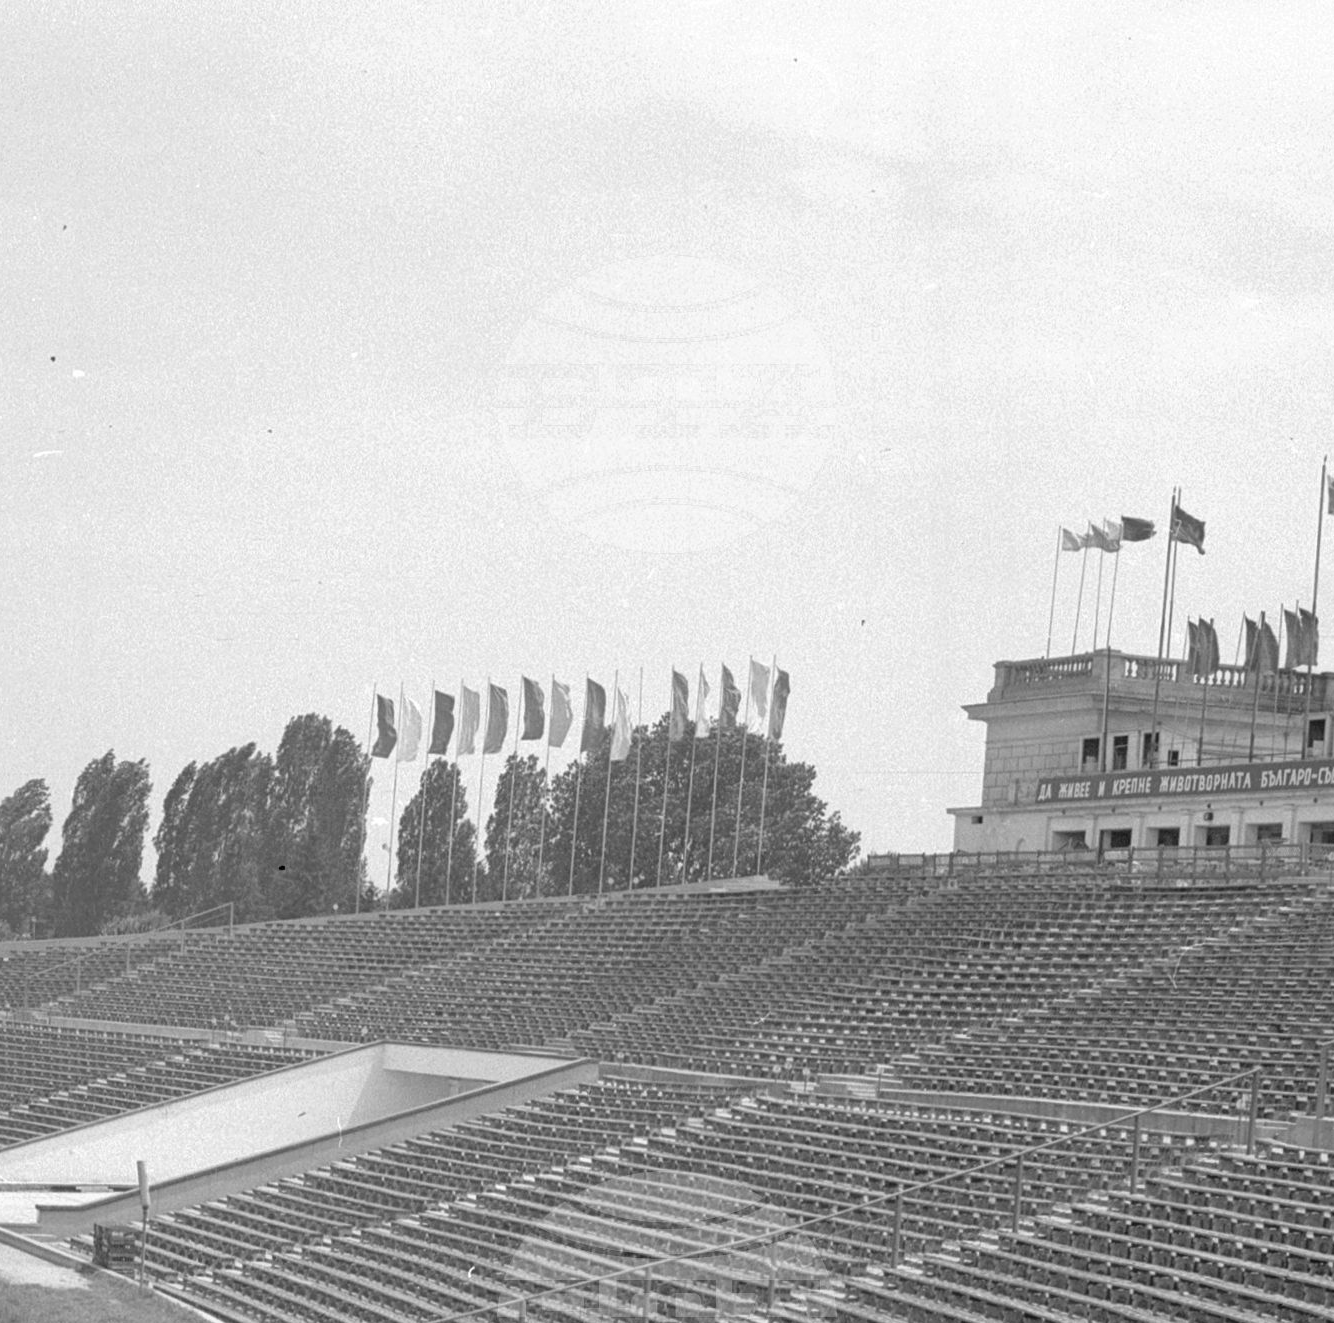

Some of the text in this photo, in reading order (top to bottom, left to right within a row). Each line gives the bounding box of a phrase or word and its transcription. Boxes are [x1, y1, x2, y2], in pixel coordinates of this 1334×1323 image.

[1038, 784, 1052, 800] ДА
[1058, 781, 1091, 798] ЖИВЕЕ
[1097, 781, 1106, 797] И
[1112, 776, 1152, 795] КРЕПНЕ
[1159, 771, 1251, 792] ЖИВОТВОРНАТА
